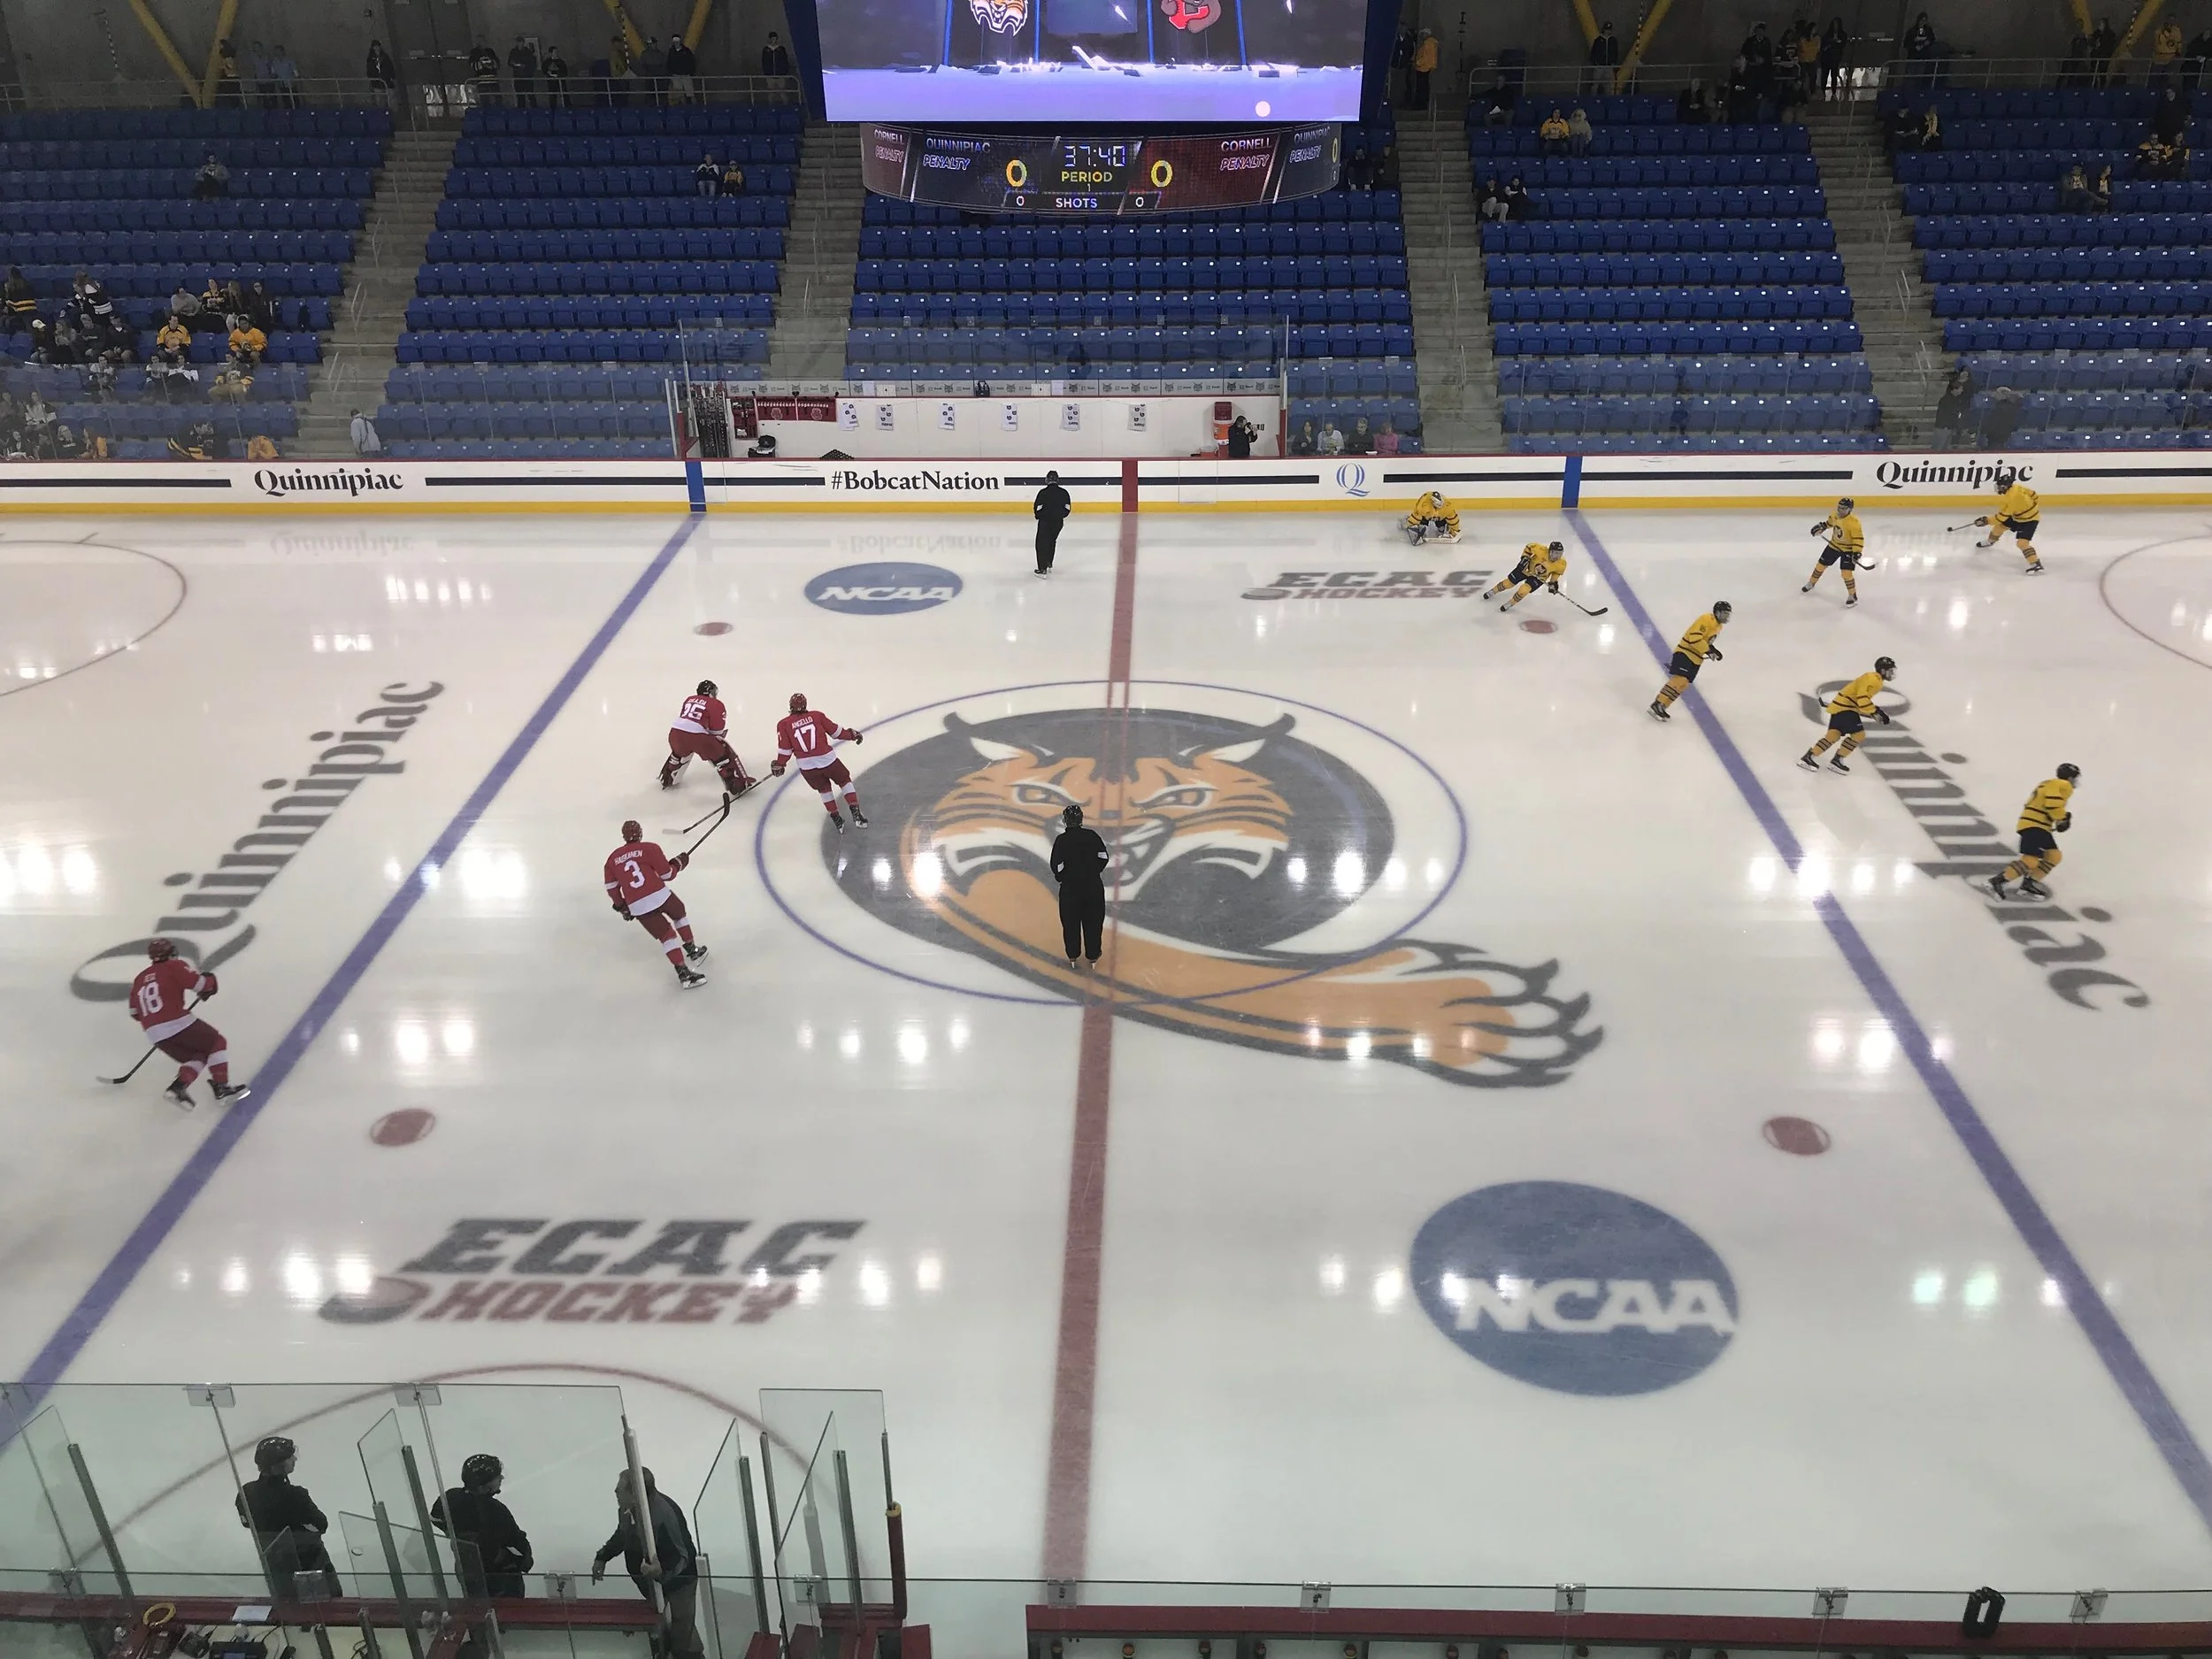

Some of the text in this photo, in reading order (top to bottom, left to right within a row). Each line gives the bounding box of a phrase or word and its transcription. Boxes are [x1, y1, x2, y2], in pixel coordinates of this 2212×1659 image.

[873, 129, 905, 144] CORNELL
[926, 138, 991, 153] QUINNIPIAC
[1220, 137, 1272, 152] CORNELL
[874, 145, 905, 163] PENALTY
[923, 154, 972, 171] PENALTY
[1064, 145, 1126, 167] 37:40
[1220, 154, 1271, 171] PENALTY
[1289, 145, 1323, 163] PENALTY
[1006, 159, 1028, 188] 0
[1061, 171, 1113, 182] PERIOD
[1150, 159, 1173, 188] 0
[1087, 183, 1092, 192] 1
[1015, 196, 1145, 209] 0 SHOTS 0
[254, 467, 404, 497] Quinnipiac
[831, 469, 1001, 490] #BobcatNation
[1335, 462, 1371, 497] Q
[1266, 571, 1495, 588] ECAC
[816, 586, 955, 602] NCAA
[1290, 588, 1484, 600] HOCKEY
[793, 723, 817, 753] 17
[70, 680, 445, 1002] Quinnipiac
[624, 859, 646, 889] 3
[136, 981, 164, 1018] 18
[397, 1217, 869, 1276] ECAC
[415, 1279, 800, 1325] HOCKEY
[1454, 1277, 1739, 1336] NCAA
